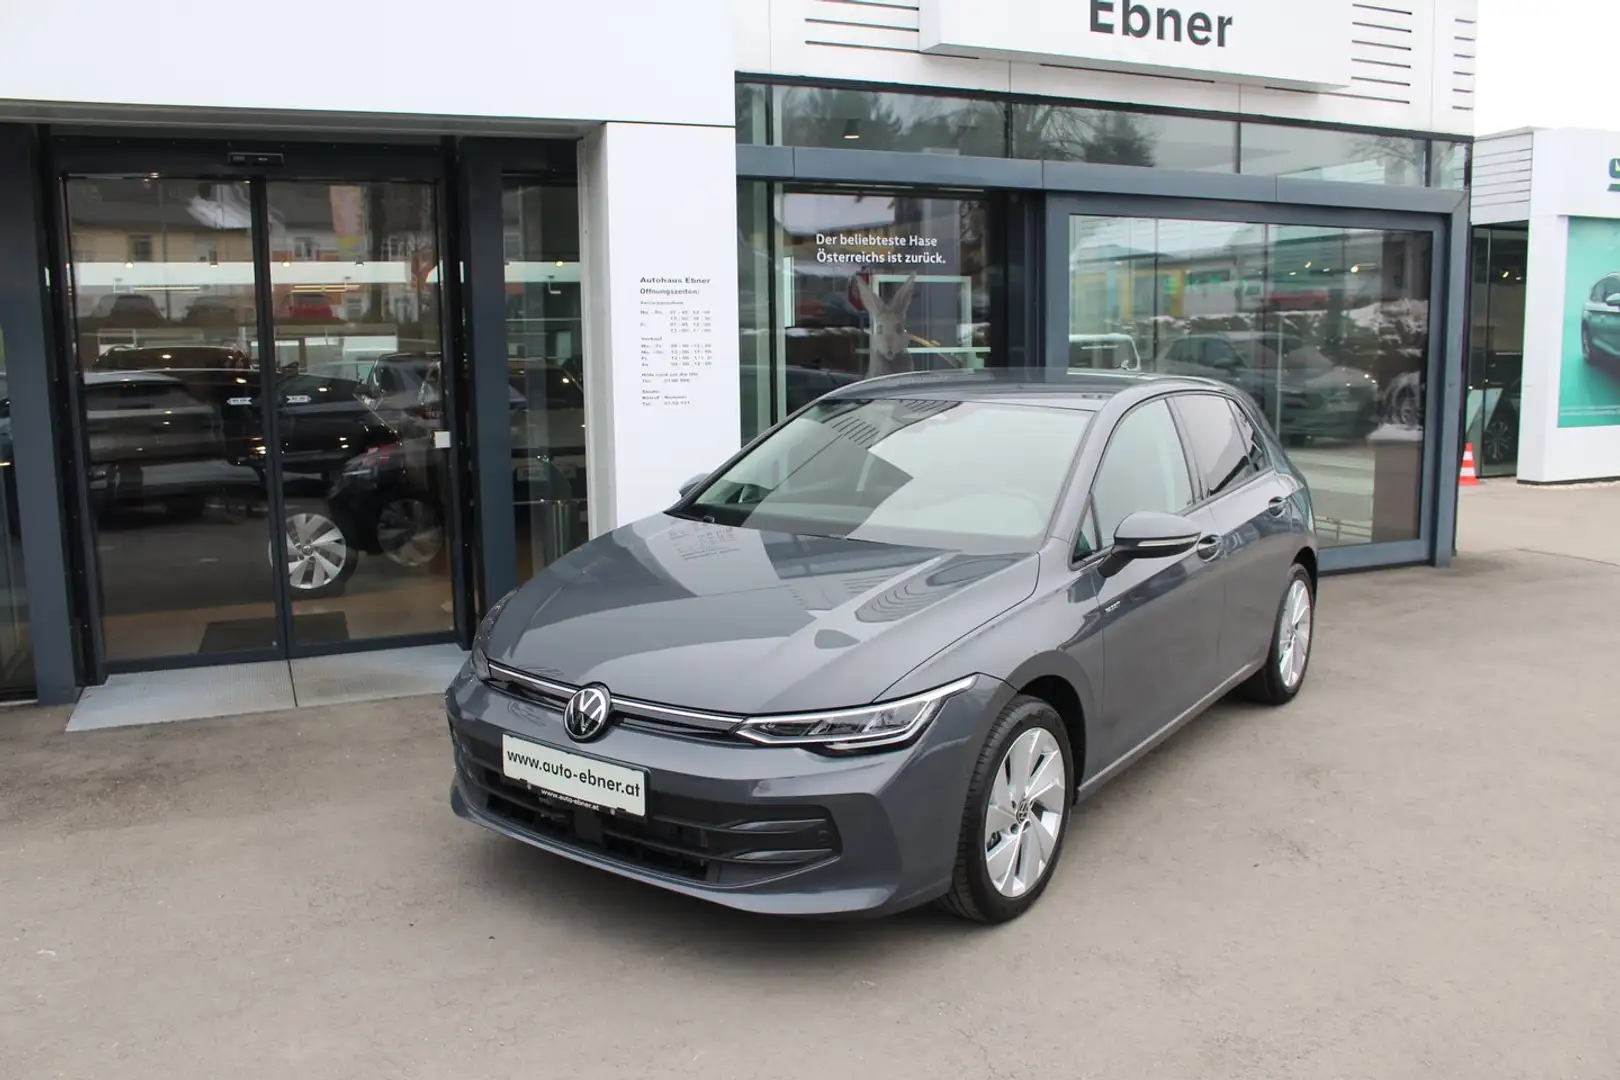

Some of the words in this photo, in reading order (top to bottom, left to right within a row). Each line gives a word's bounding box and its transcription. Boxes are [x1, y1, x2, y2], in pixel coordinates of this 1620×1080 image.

[1090, 0, 1233, 47] Ebner
[816, 234, 837, 245] Der
[840, 234, 906, 246] beliebteste
[909, 235, 938, 247] Hase
[816, 248, 885, 263] Österreichs
[887, 252, 902, 263] ist
[905, 251, 946, 264] zurück.
[640, 276, 683, 284] Autohaus
[685, 276, 711, 284] Ebner
[507, 750, 640, 797] www.auto-ebner.at
[541, 788, 600, 812] www.auto-ebner.at
